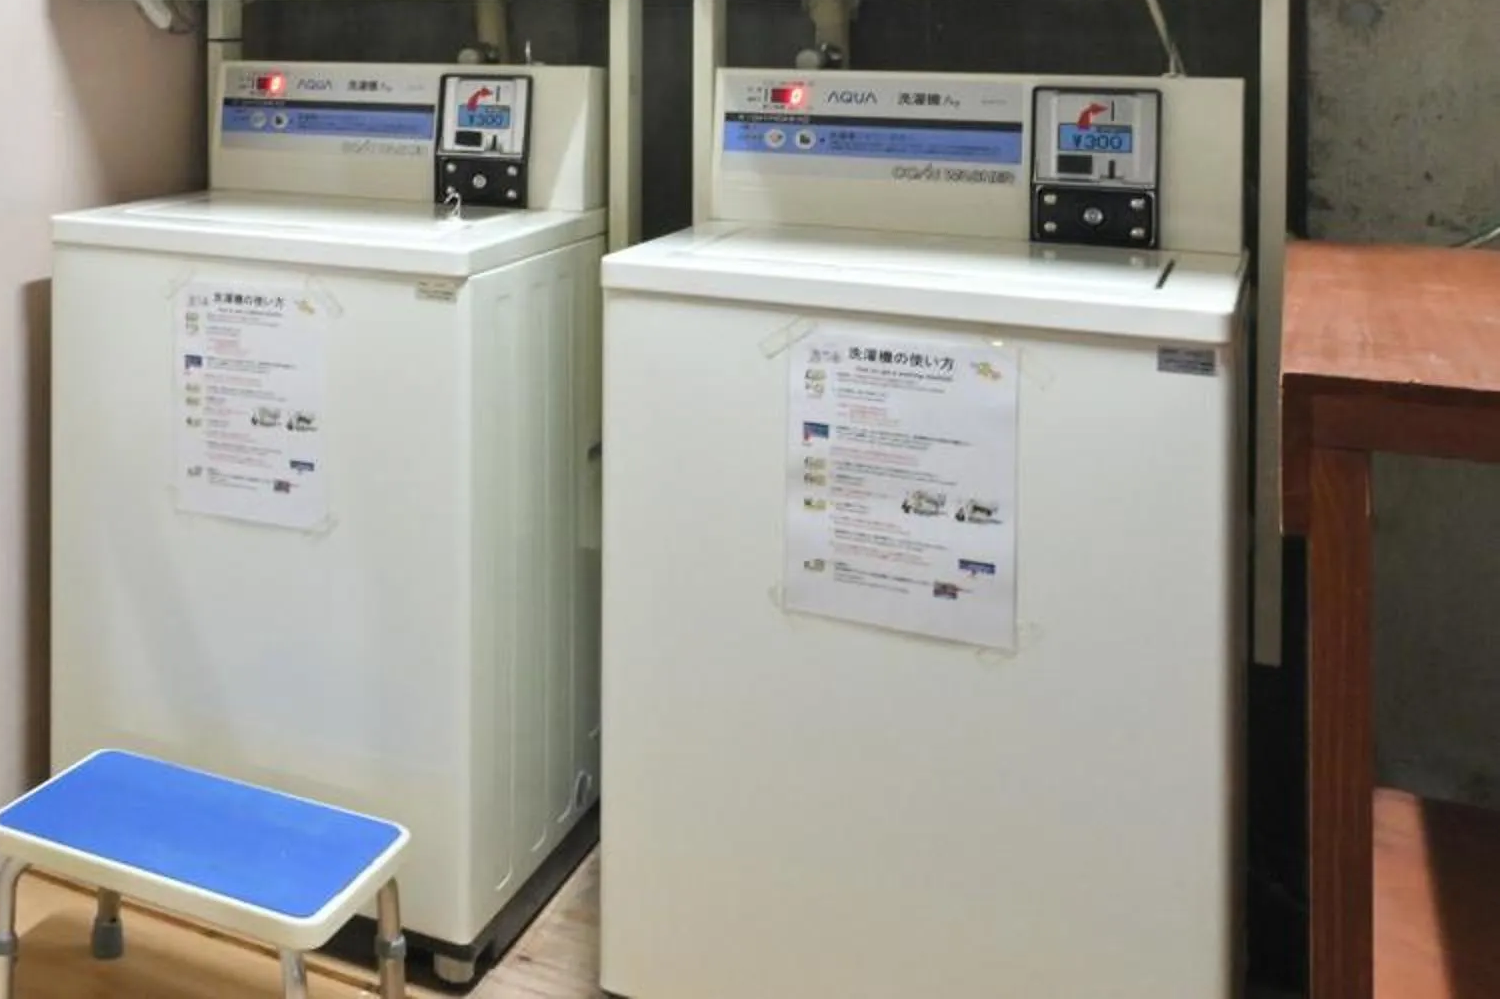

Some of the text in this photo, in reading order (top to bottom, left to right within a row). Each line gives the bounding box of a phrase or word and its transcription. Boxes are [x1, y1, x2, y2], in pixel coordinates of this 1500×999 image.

[297, 78, 333, 91] AQUA
[827, 91, 878, 104] AQUA
[897, 92, 942, 106] 洗濯機
[1072, 133, 1124, 150] ¥300
[848, 347, 956, 372] 洗濯機の使い方
